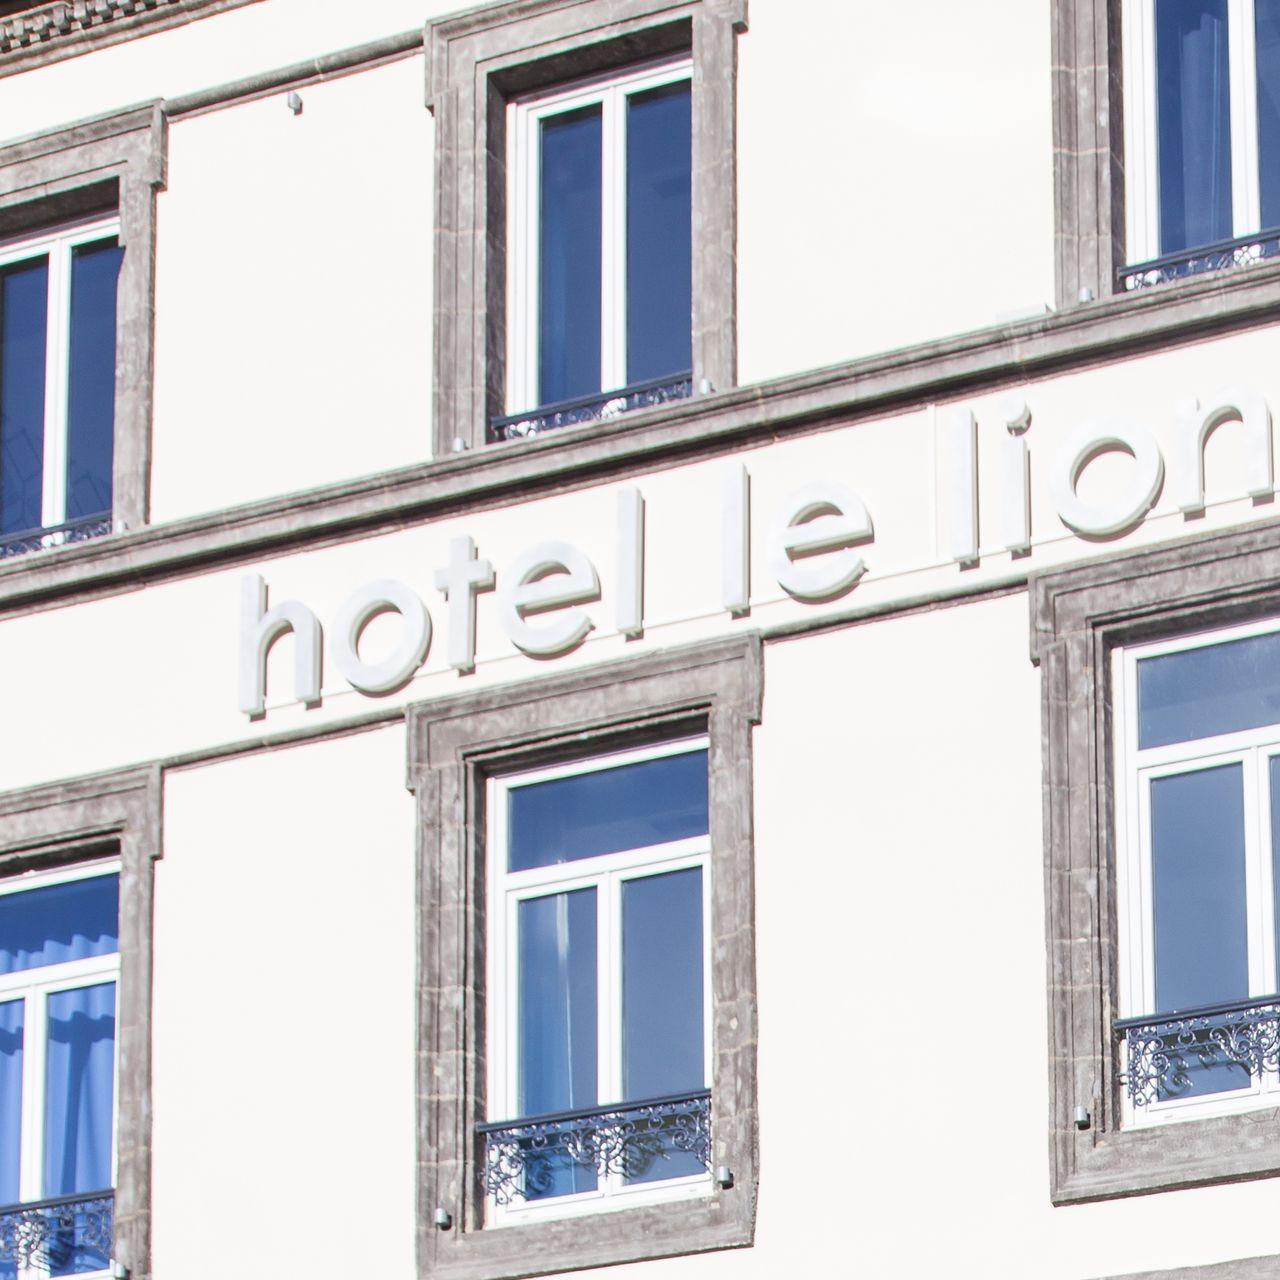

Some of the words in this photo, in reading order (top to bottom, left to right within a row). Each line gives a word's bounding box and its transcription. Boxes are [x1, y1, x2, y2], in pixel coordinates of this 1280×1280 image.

[239, 485, 646, 720] hotel
[720, 462, 875, 620] le
[946, 384, 1275, 570] lion
